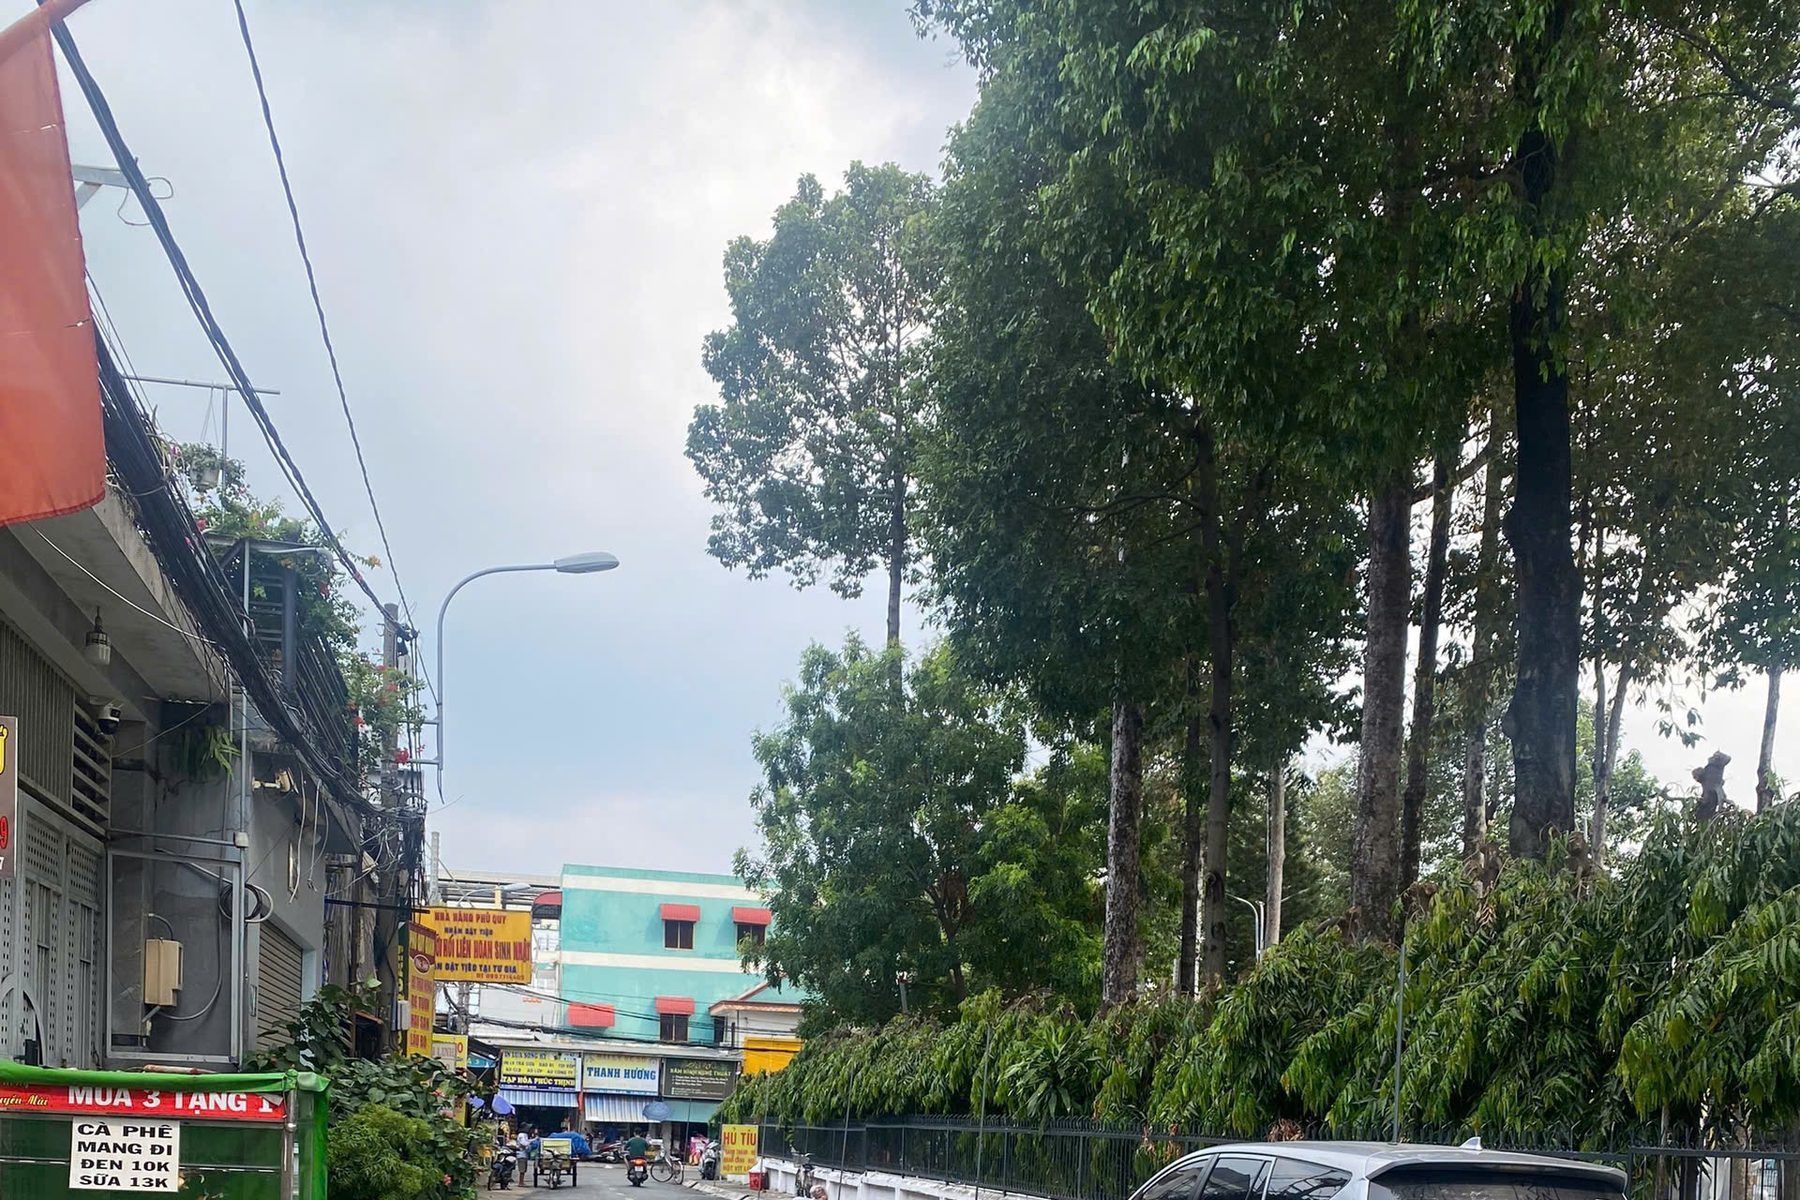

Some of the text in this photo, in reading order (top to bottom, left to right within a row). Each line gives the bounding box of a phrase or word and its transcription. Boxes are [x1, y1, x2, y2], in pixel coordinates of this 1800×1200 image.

[503, 1076, 517, 1085] TẠP
[586, 1067, 622, 1079] THANH
[623, 1067, 657, 1081] HƯƠNG
[68, 1086, 132, 1108] MUA
[142, 1089, 161, 1108] 3
[78, 1121, 172, 1138] CÀ PHÊ
[723, 1127, 737, 1145] HỦ
[77, 1141, 172, 1155] MANG ĐI
[81, 1158, 169, 1172] ĐEN 10K
[79, 1173, 168, 1188] SỮA 13K
